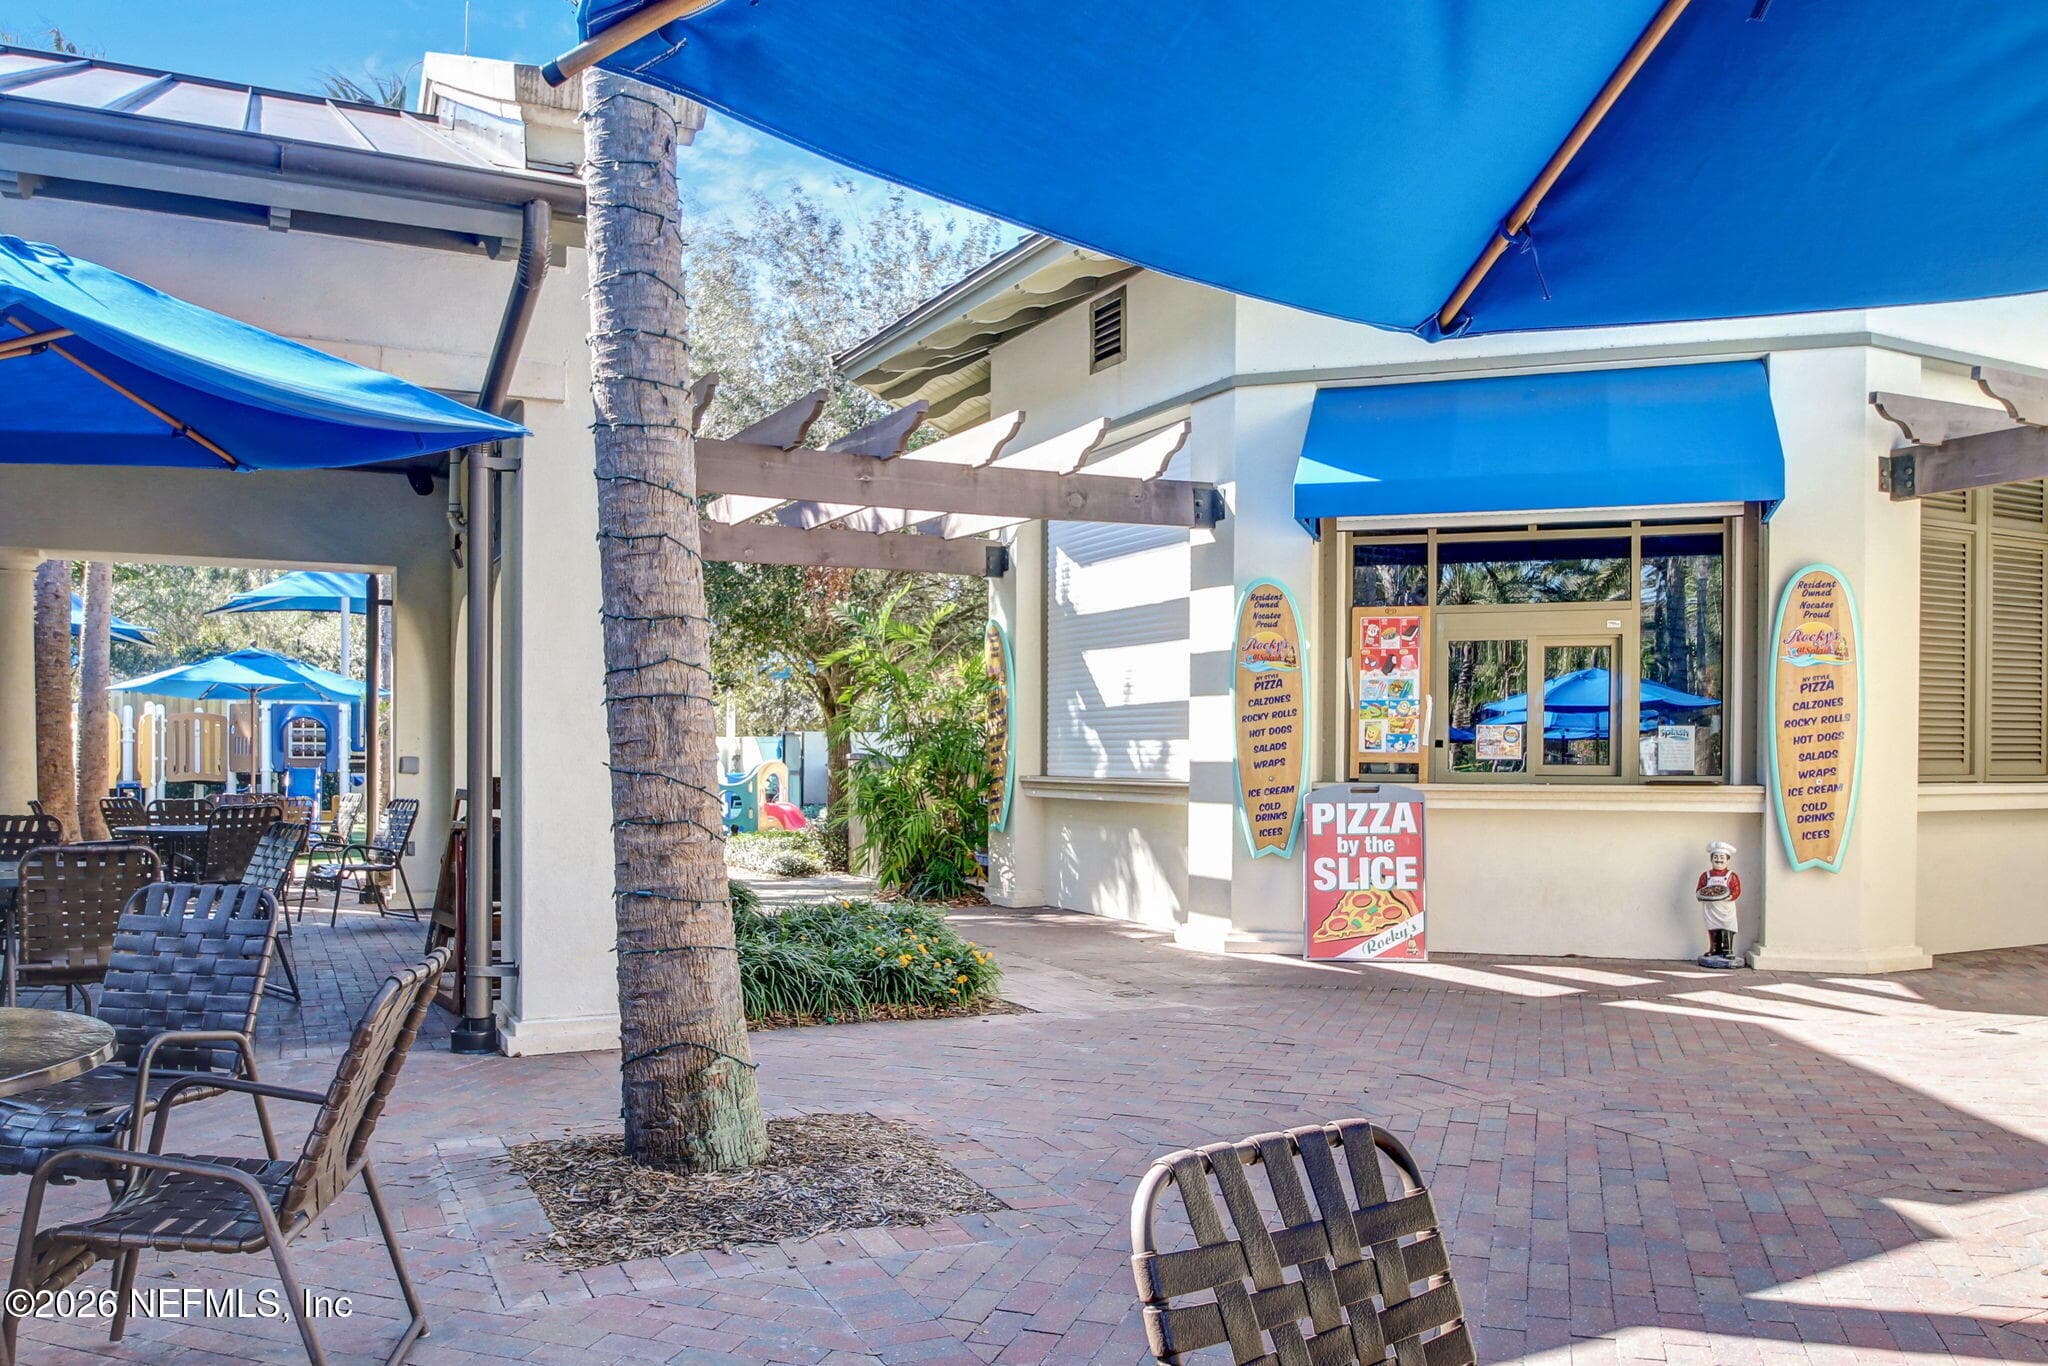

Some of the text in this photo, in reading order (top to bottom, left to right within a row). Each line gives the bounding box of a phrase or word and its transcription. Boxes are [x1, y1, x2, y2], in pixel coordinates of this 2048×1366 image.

[1797, 580, 1836, 589] Resident
[1250, 593, 1283, 601] Resident
[1802, 589, 1832, 597] Owned
[1254, 601, 1280, 609] Owned
[1800, 601, 1834, 609] Nocatee
[1253, 612, 1282, 620] Nocatee
[1803, 610, 1831, 618] Proud
[1255, 620, 1279, 628] Proud
[1783, 629, 1840, 645] Rocky's
[1242, 637, 1289, 652] Rocky's
[1254, 679, 1283, 691] PIZZA
[1800, 680, 1834, 694] PIZZA
[1248, 694, 1291, 707] CALZONES
[1792, 697, 1844, 711] CALZONES
[1241, 708, 1298, 723] ROCKY ROLLS
[1784, 713, 1851, 728] ROCKY ROLLS
[1249, 725, 1293, 738] HOT DOGS
[1793, 731, 1845, 745] HOT DOGS
[1253, 742, 1287, 753] SALADS
[1798, 749, 1838, 762] SALADS
[1253, 758, 1286, 769] WRAPS
[1798, 767, 1837, 779] WRAPS
[1248, 785, 1295, 798] ICE CREAM
[1788, 783, 1844, 797] ICE CREAM
[1259, 802, 1281, 812] COLD
[1801, 802, 1828, 812] COLD
[1255, 812, 1288, 822] DRINKS
[1312, 803, 1418, 835] PIZZA
[1797, 812, 1835, 824] DRINKS
[1259, 827, 1283, 837] ICEES
[1802, 829, 1830, 840] ICEES
[1337, 836, 1396, 857] by the
[1313, 856, 1418, 891] SLICE
[1362, 922, 1418, 955] Rocky's
